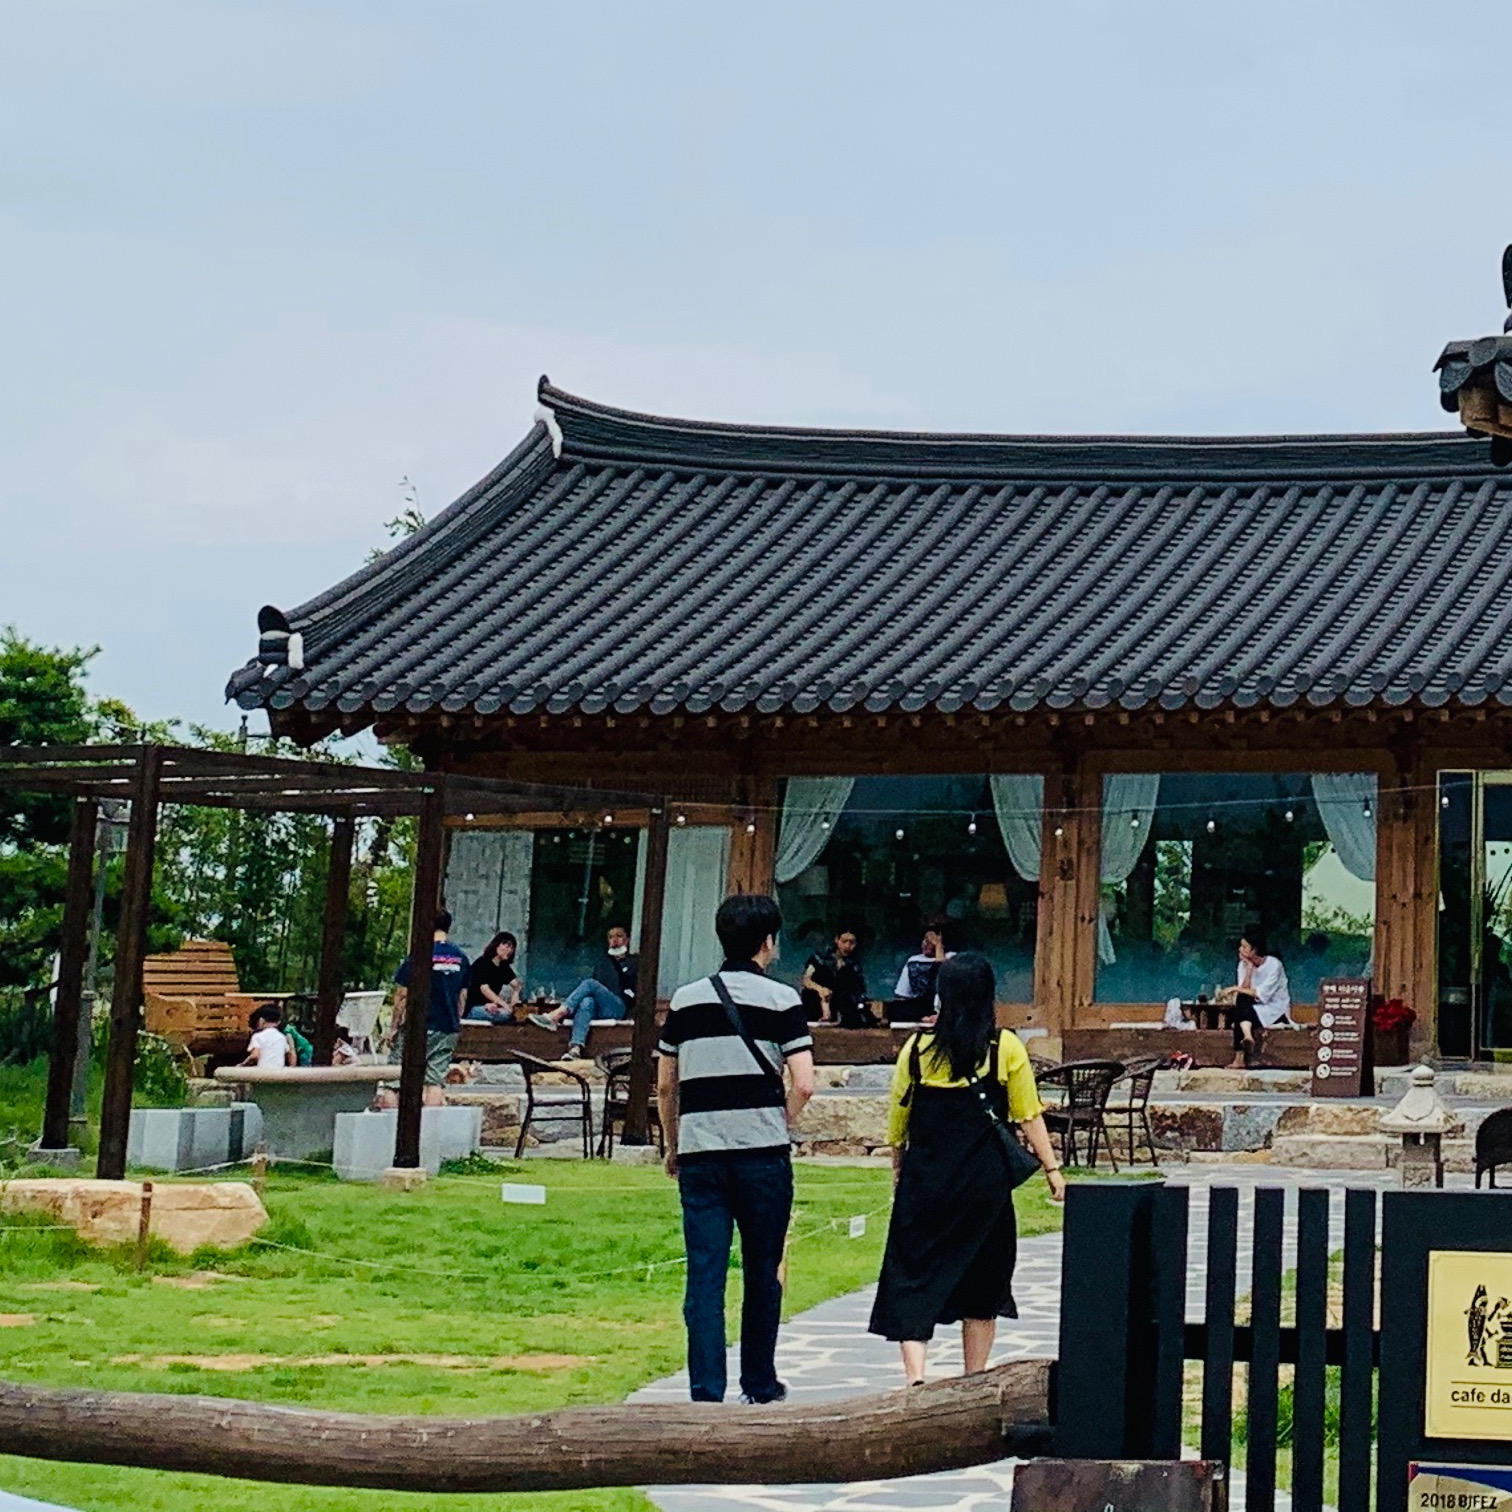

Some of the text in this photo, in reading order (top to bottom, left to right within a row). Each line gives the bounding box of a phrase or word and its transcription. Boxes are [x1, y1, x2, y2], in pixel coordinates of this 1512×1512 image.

[1451, 1388, 1486, 1402] cafe
[1420, 1493, 1498, 1510] 2018 BJFEZ
